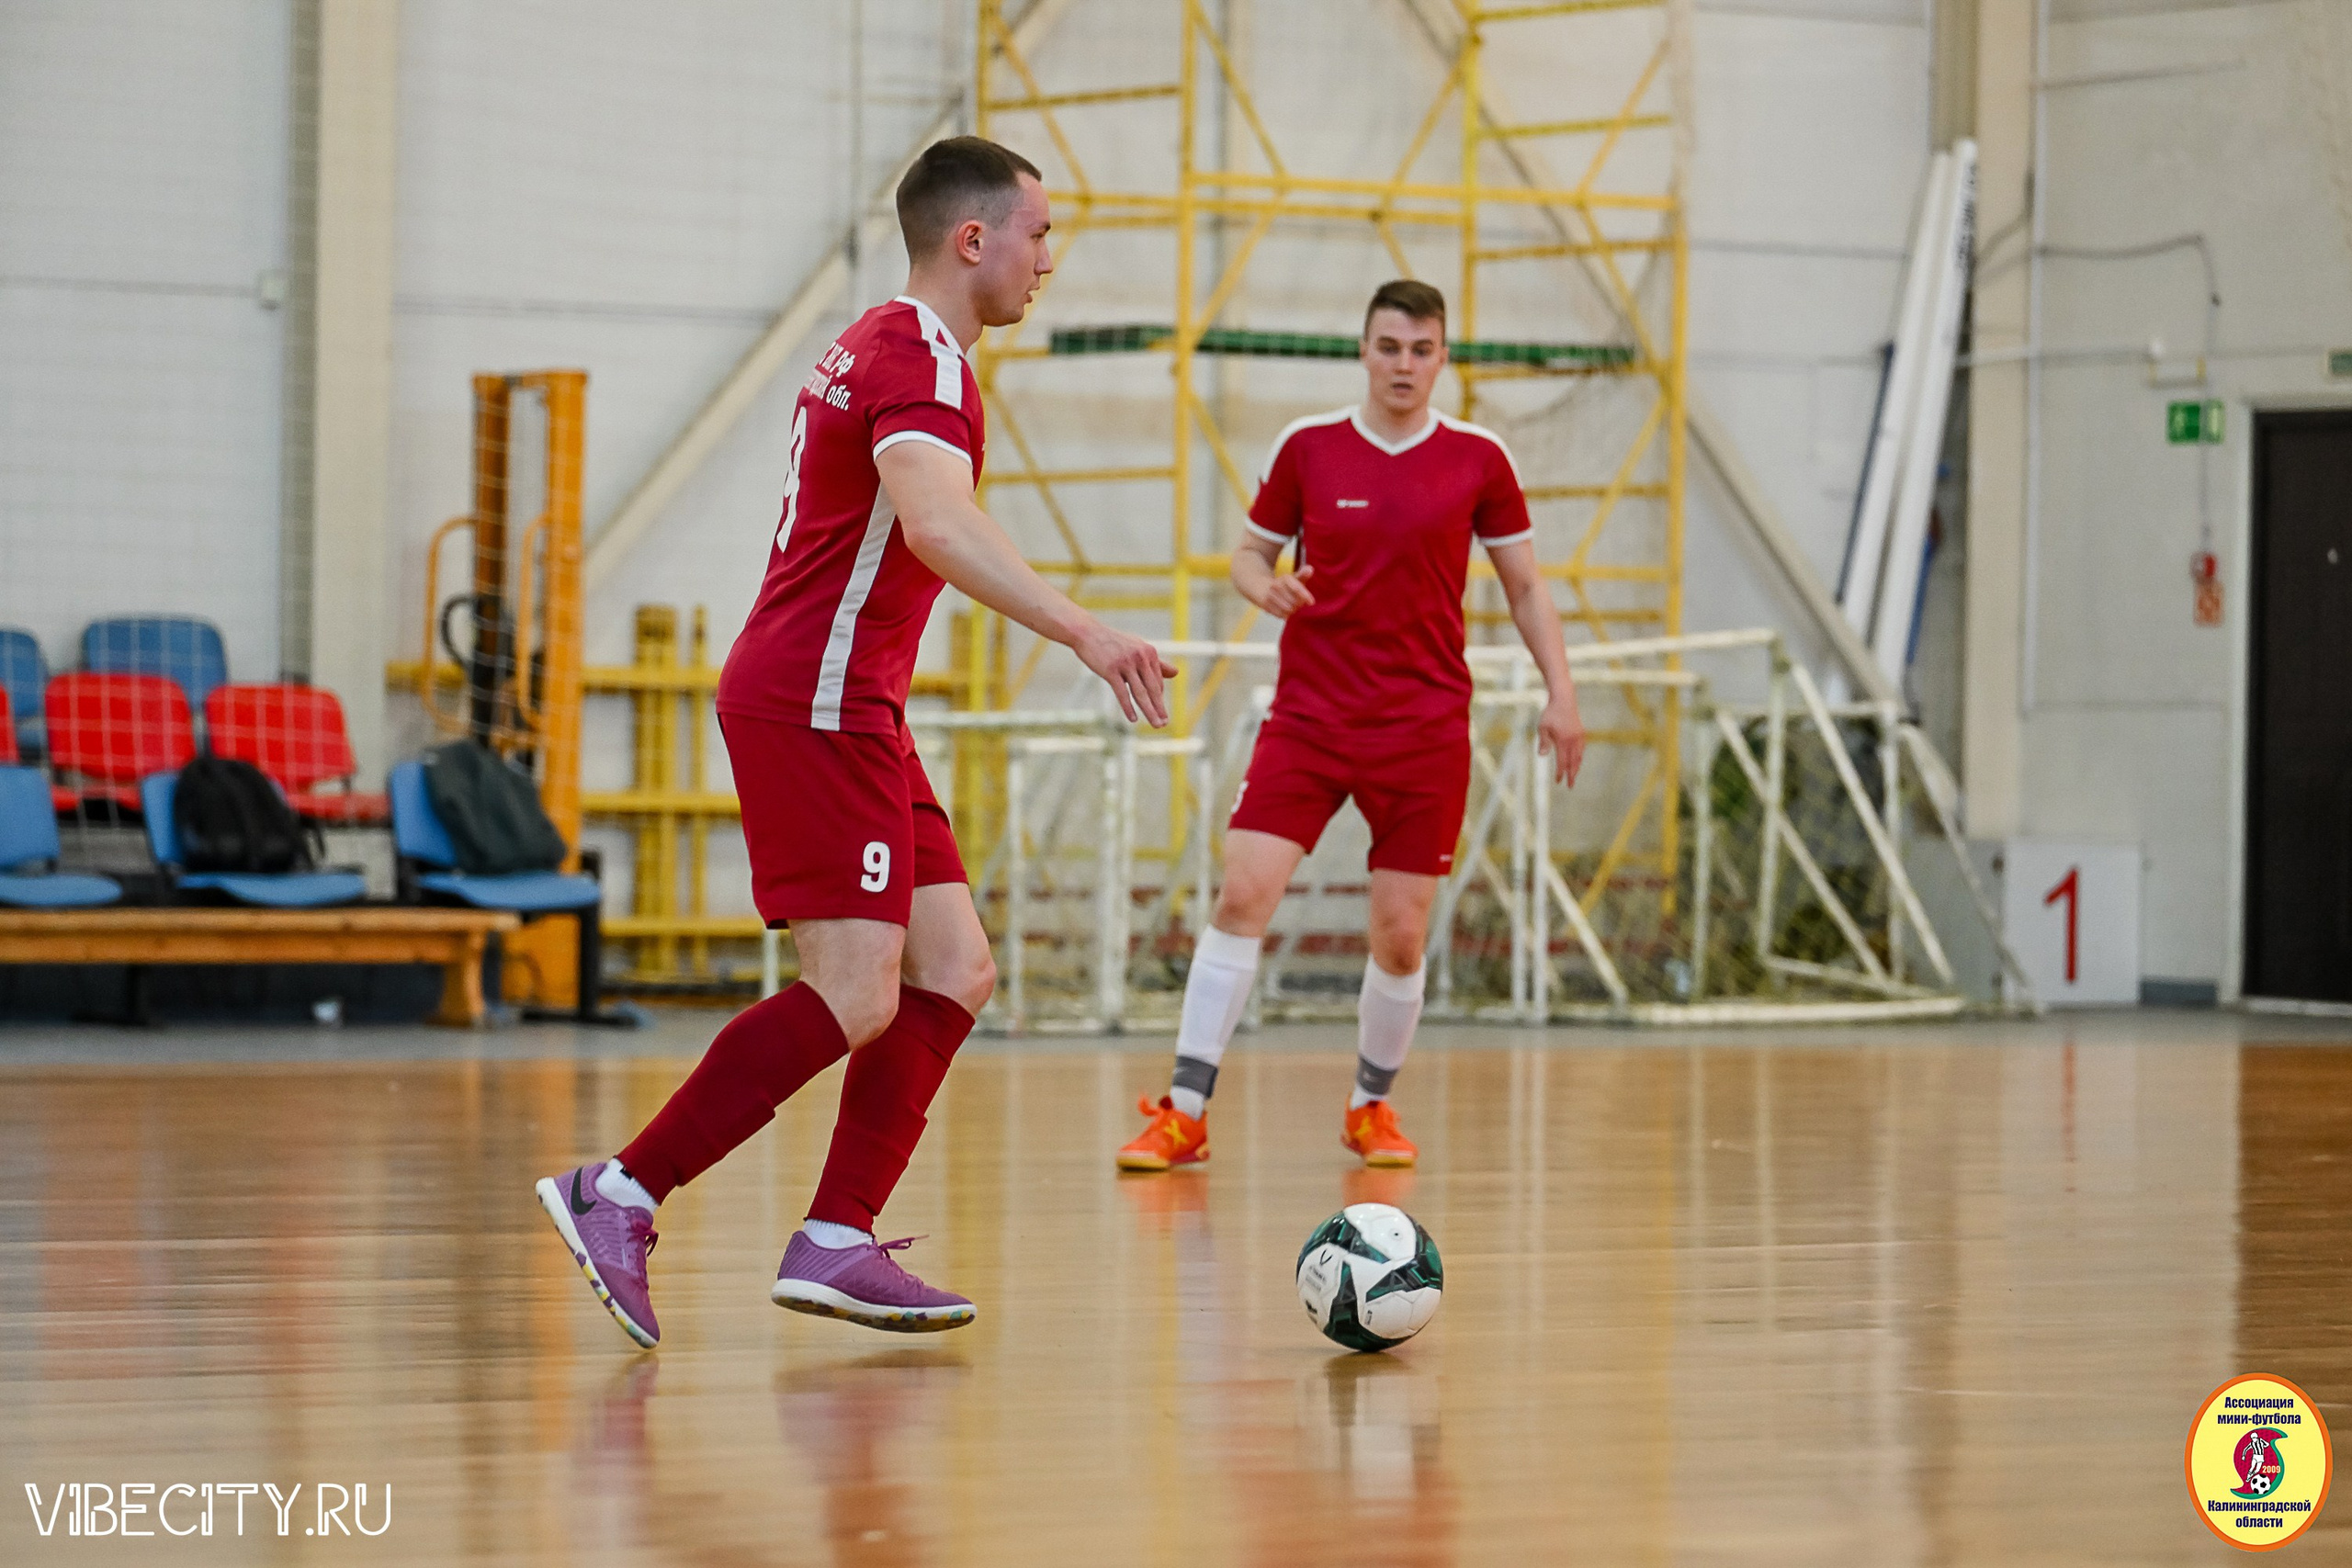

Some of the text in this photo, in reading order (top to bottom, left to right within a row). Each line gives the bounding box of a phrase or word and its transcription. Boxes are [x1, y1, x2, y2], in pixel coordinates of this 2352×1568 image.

[830, 350, 855, 378] РФ
[826, 384, 852, 411] обл.
[861, 840, 890, 893] 9
[2042, 866, 2079, 984] 1
